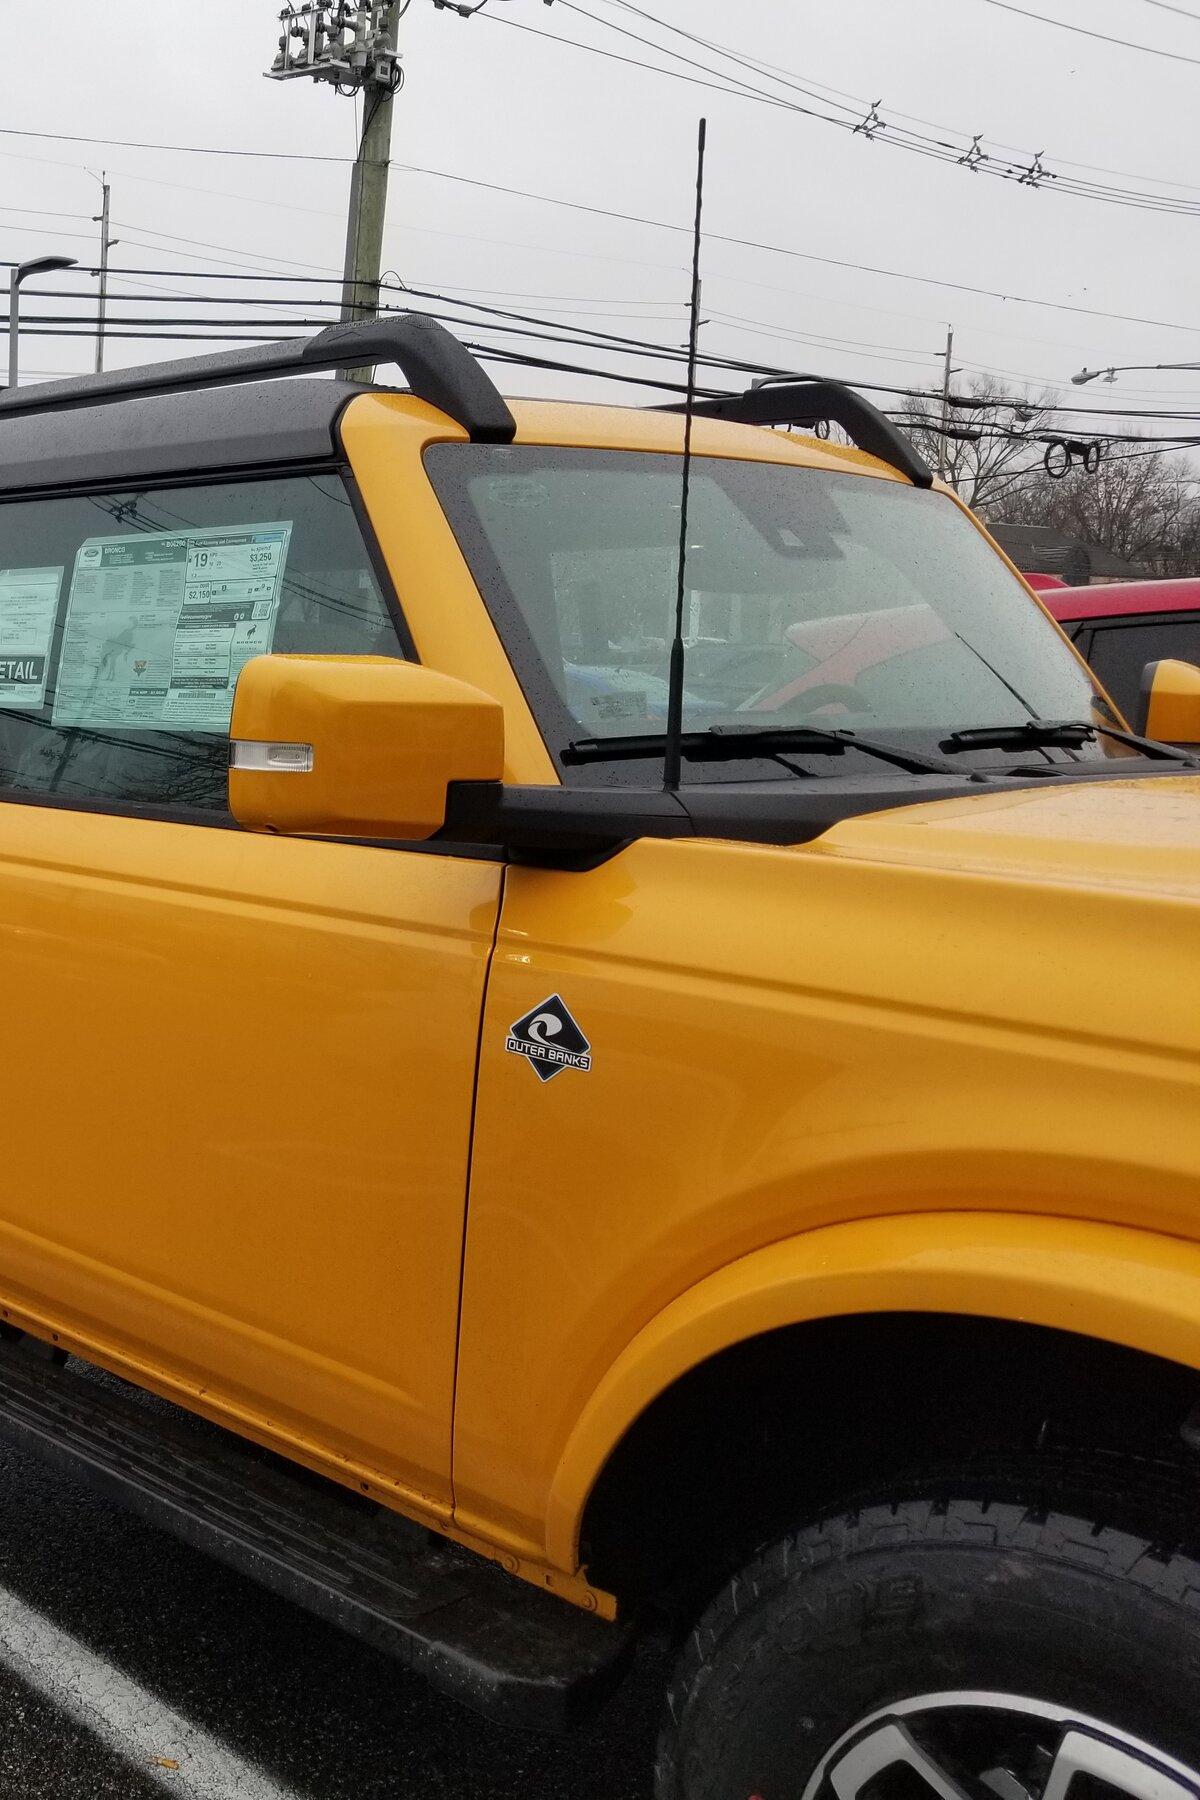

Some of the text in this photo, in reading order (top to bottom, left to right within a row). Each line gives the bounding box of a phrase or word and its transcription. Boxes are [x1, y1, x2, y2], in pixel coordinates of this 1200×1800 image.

[194, 553, 208, 567] 19
[249, 552, 272, 563] $3,250
[188, 590, 210, 599] $2,150
[508, 1040, 589, 1068] OUTER BANKS
